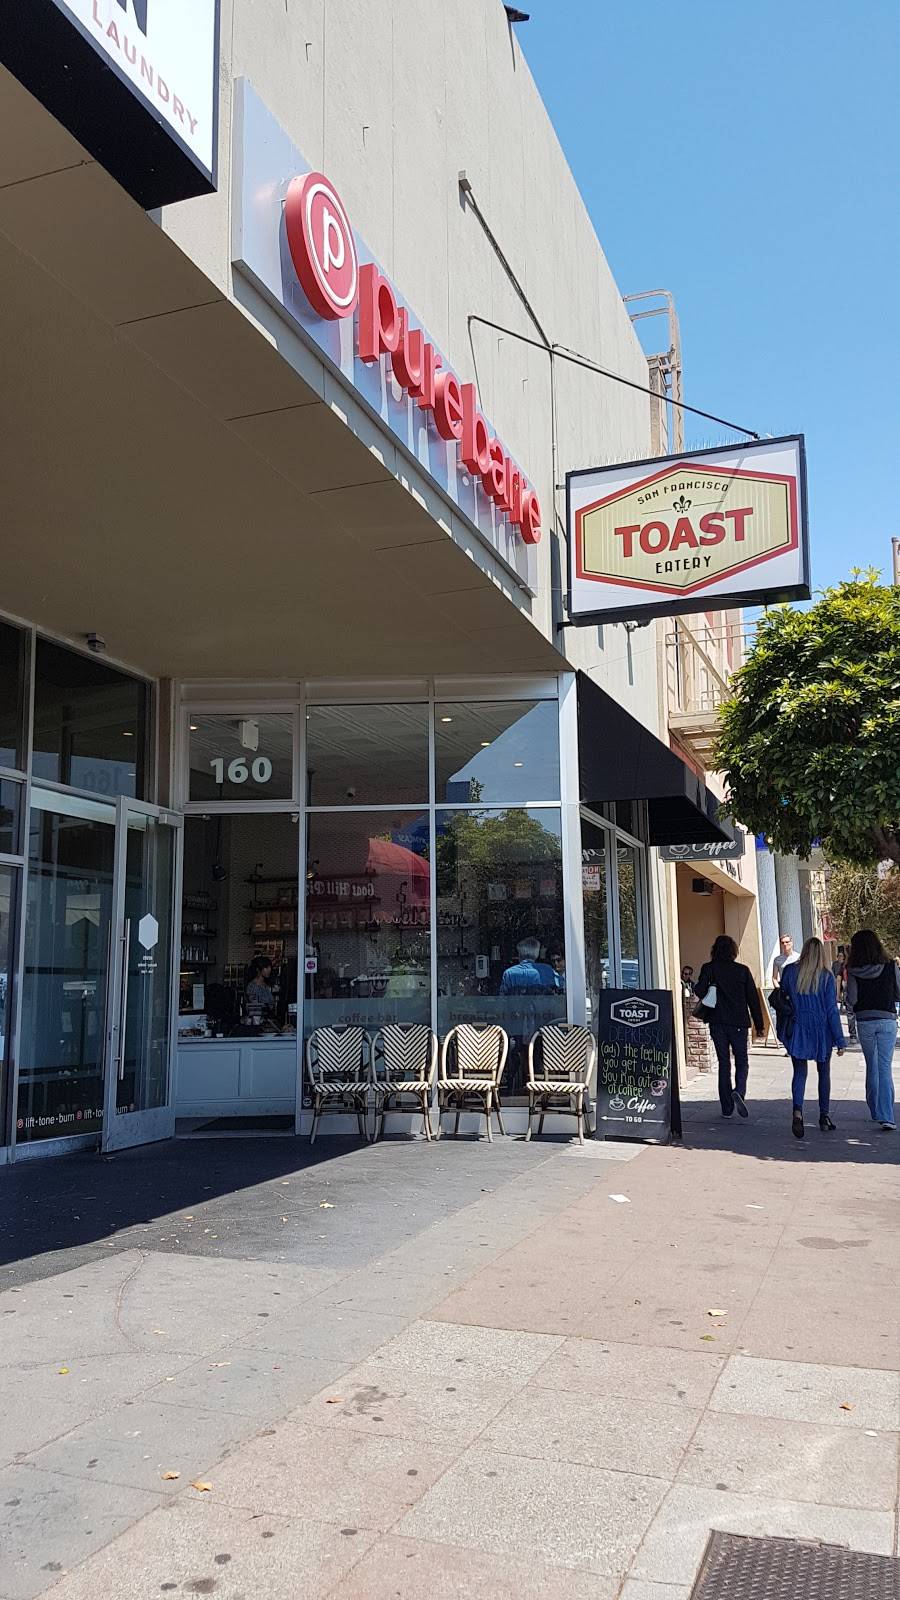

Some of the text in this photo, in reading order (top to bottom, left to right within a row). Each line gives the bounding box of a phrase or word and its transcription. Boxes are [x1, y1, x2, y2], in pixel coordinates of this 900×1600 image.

[92, 0, 198, 136] LAUNDRY
[637, 481, 729, 505] SAN FRANCISCO
[614, 507, 753, 558] TOAST
[656, 555, 712, 574] EATERY
[209, 756, 273, 784] 160
[619, 1009, 650, 1018] TOAST
[623, 1043, 639, 1058] the
[640, 1044, 670, 1066] feeling
[603, 1058, 619, 1072] you
[621, 1059, 637, 1074] get
[601, 1071, 618, 1084] you
[638, 1074, 651, 1088] out
[608, 1082, 617, 1094] of
[627, 1097, 656, 1113] Coffee
